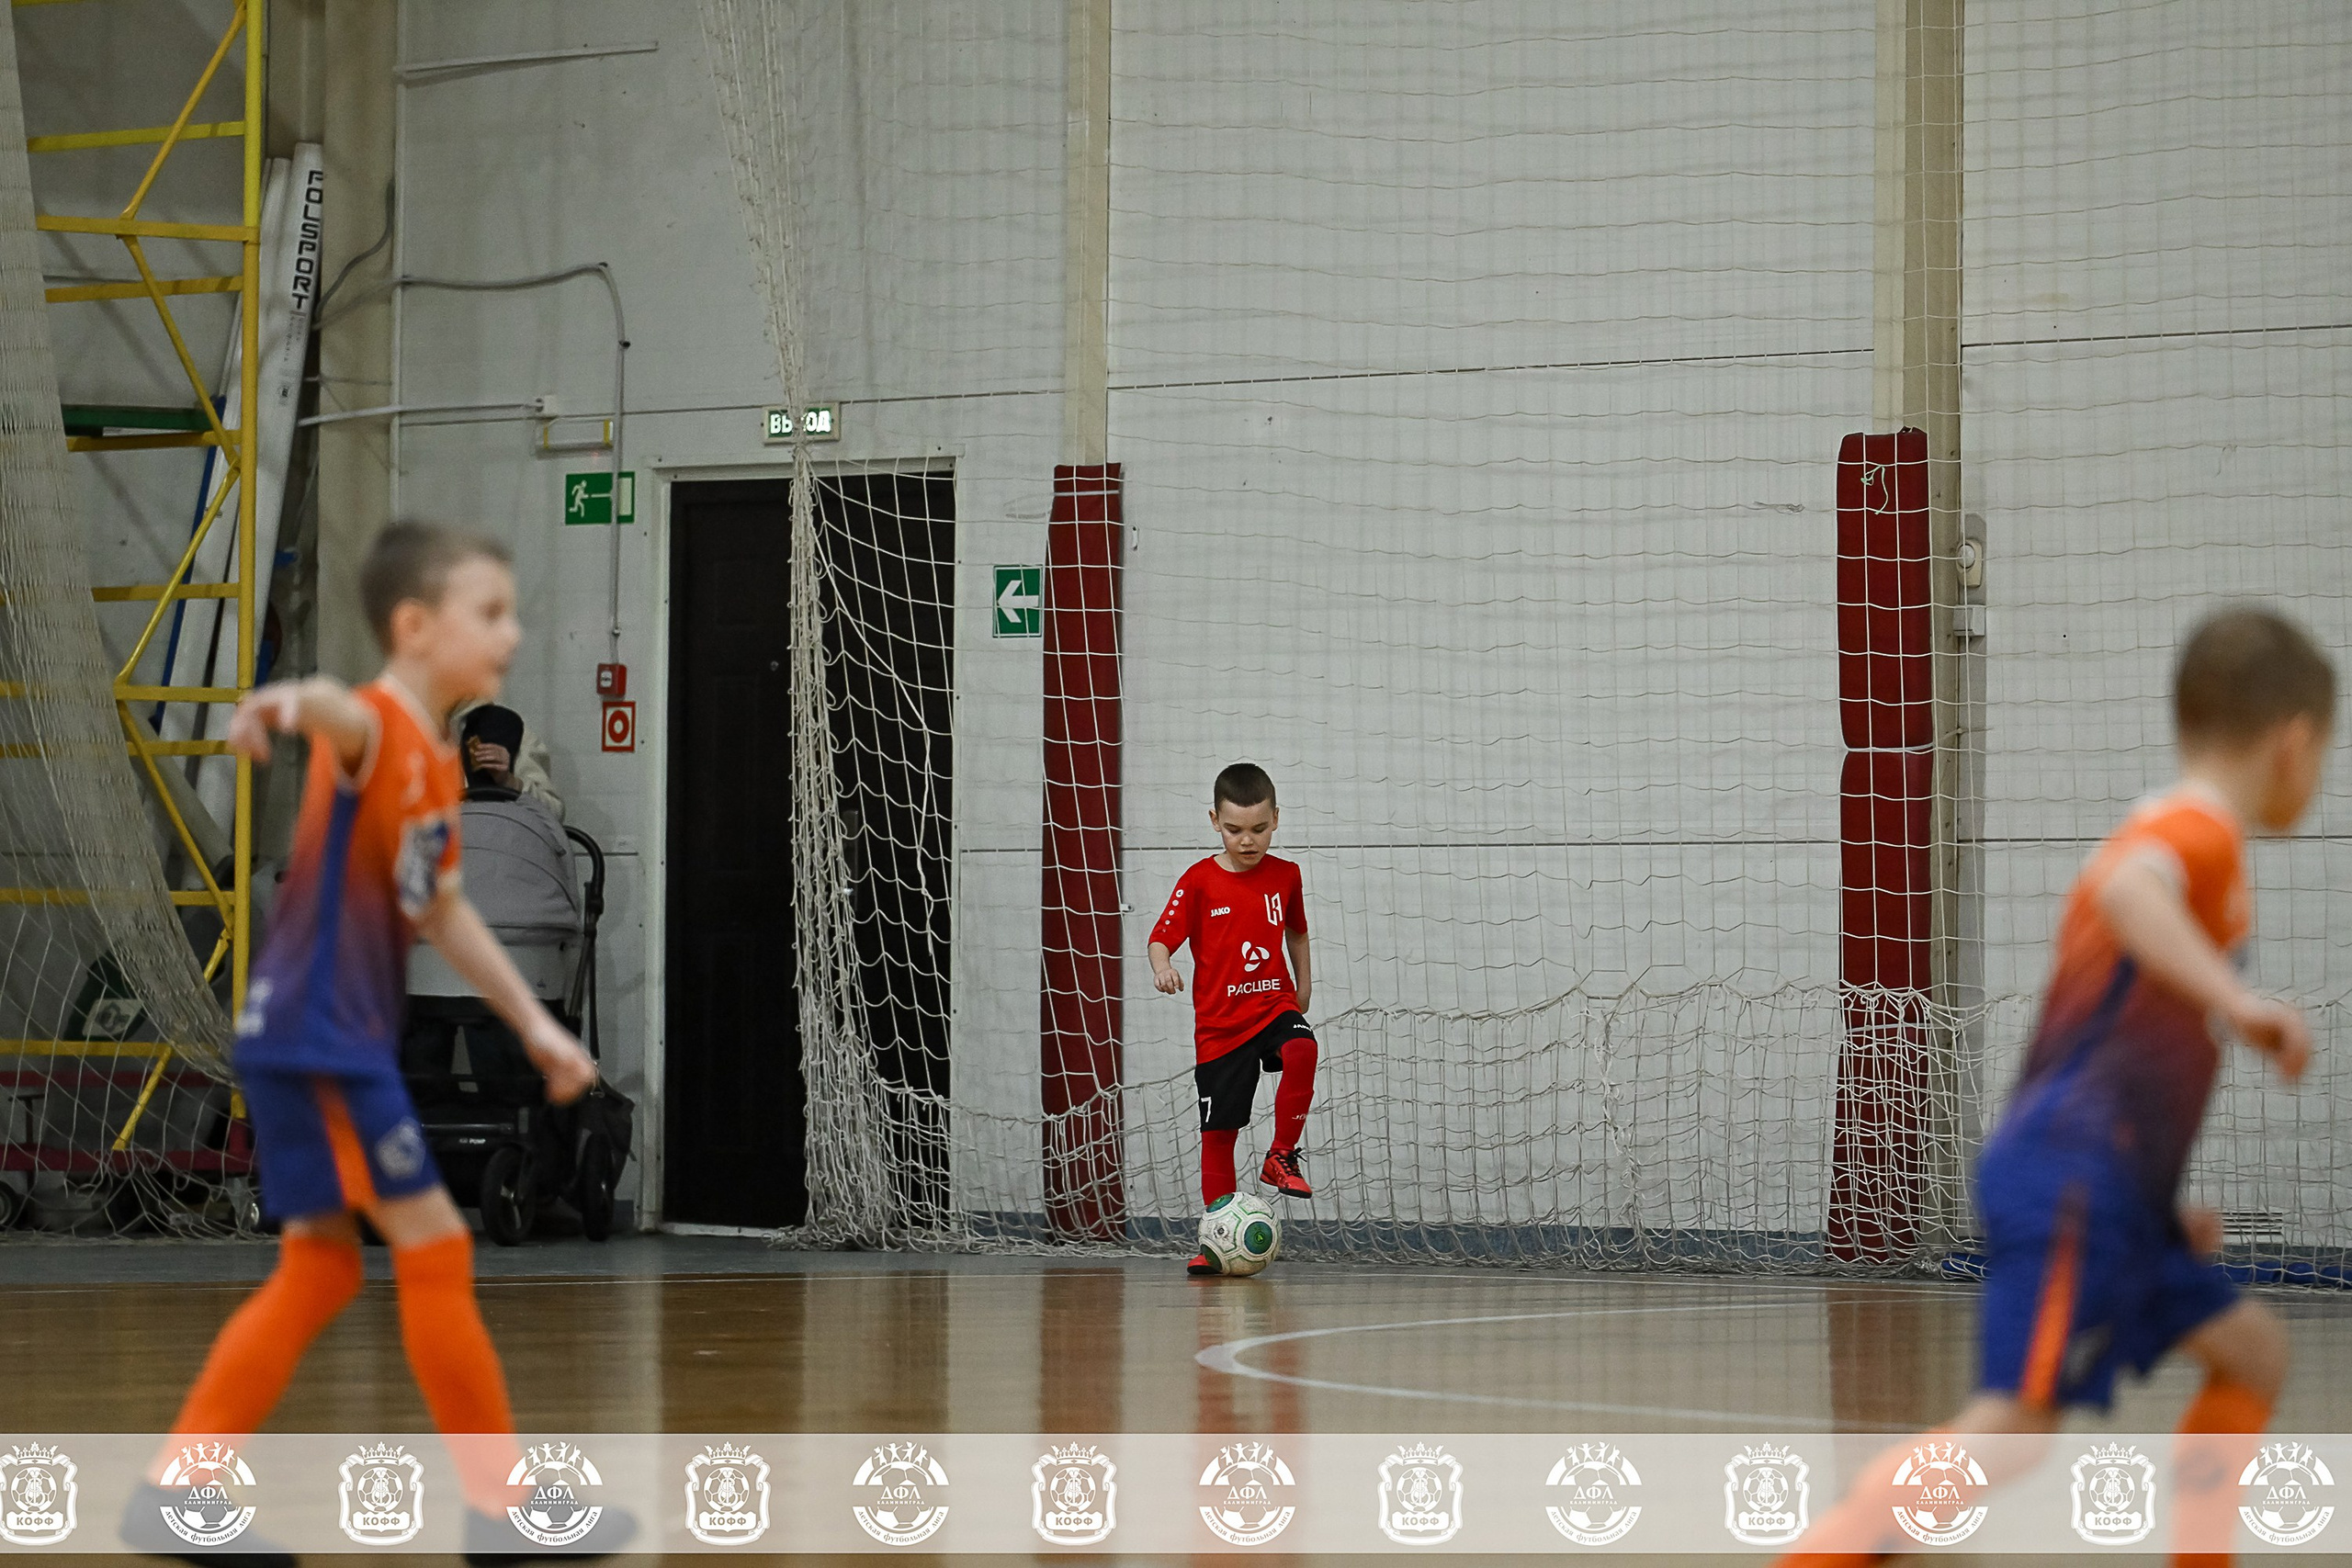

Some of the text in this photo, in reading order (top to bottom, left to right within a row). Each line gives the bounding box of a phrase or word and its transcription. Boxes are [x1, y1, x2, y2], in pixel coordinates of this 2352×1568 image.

[770, 410, 831, 434] ВЫОД
[1211, 907, 1230, 917] JAKO
[1227, 978, 1282, 997] РАСЦВЕ
[1200, 1096, 1212, 1122] 7
